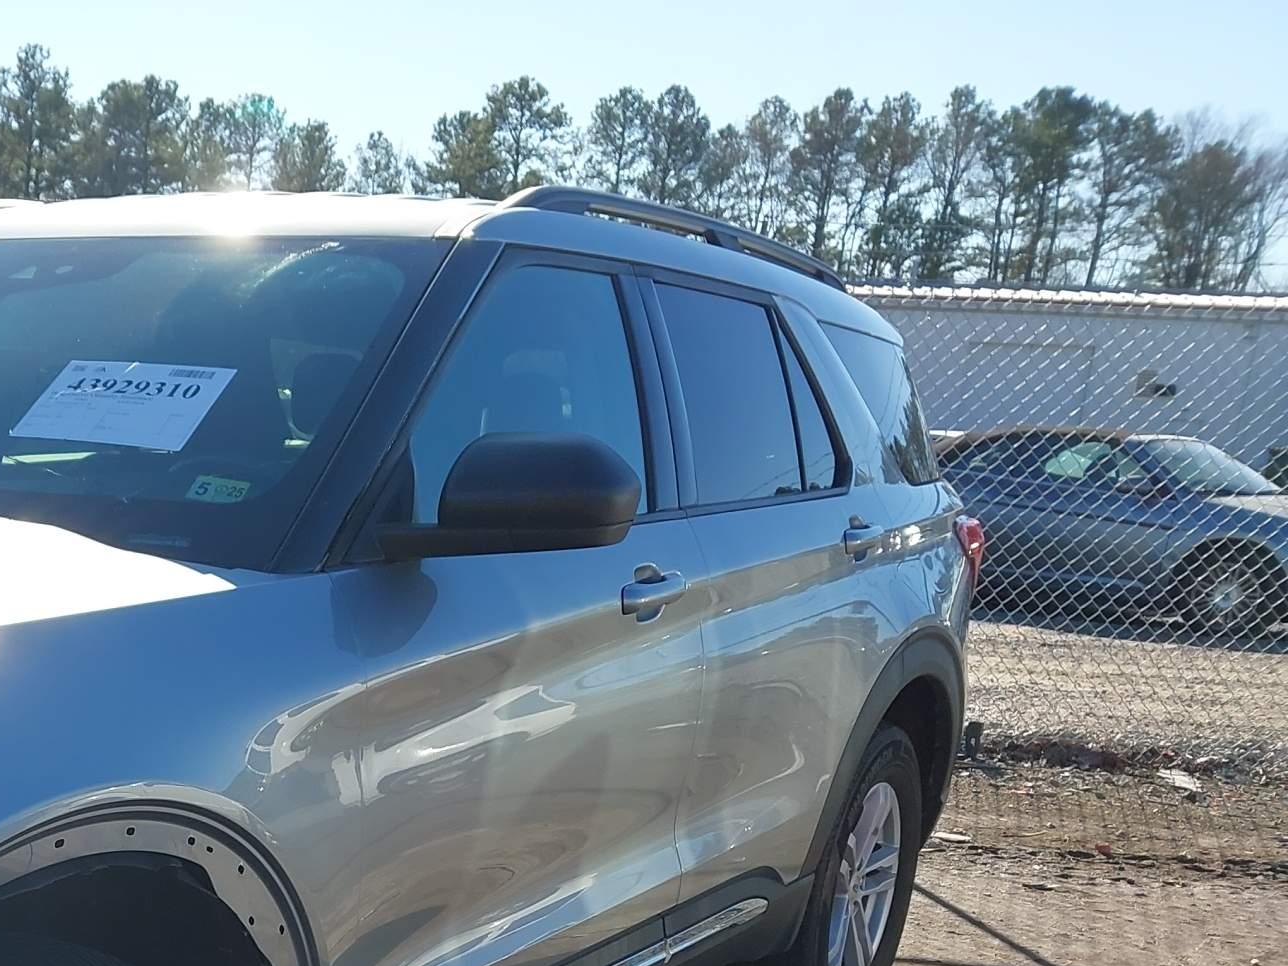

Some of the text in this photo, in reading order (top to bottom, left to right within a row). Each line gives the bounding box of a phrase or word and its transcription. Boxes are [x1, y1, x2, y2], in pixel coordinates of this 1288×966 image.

[66, 376, 202, 400] 43929310
[194, 481, 246, 498] 5 25
